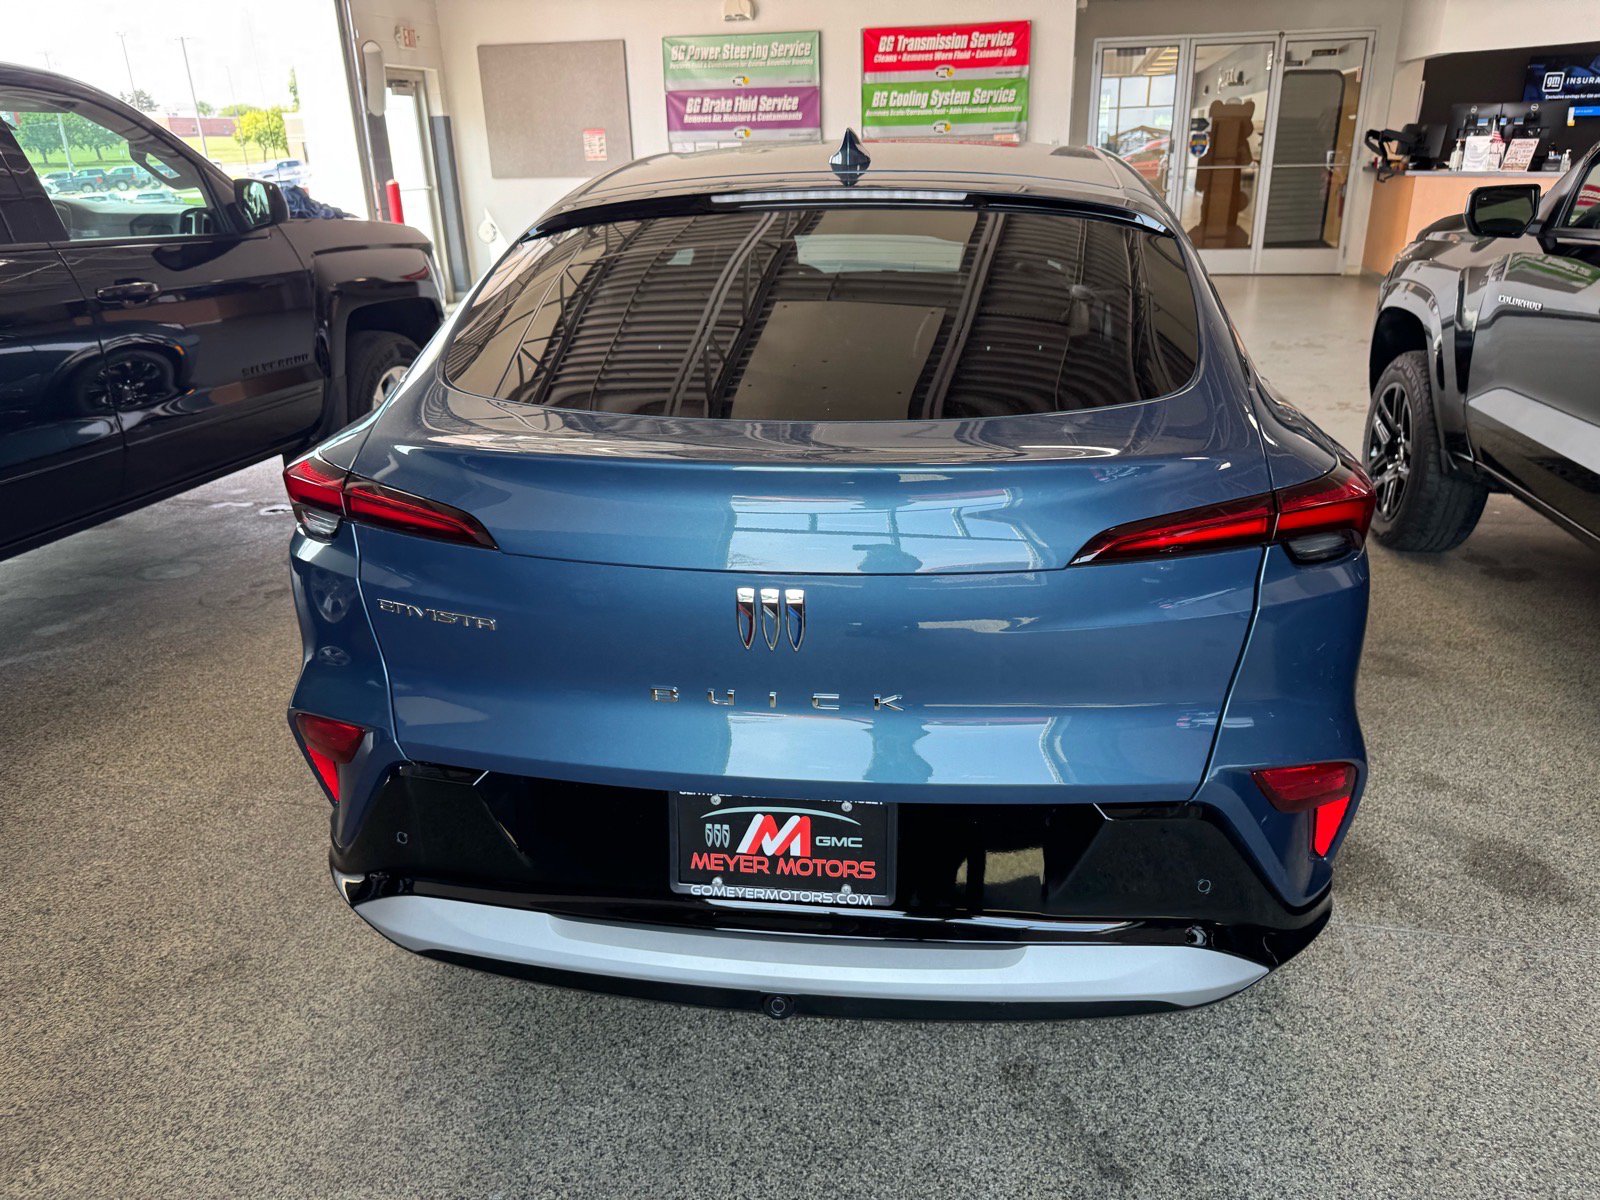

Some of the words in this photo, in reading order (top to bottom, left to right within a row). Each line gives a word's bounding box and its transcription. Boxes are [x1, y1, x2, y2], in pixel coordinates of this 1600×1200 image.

[671, 45, 686, 61] BG
[687, 46, 721, 60] Power
[722, 42, 769, 60] Steering
[771, 40, 812, 58] Service
[878, 35, 895, 52] BG
[896, 32, 969, 51] Transmission
[970, 30, 1015, 48] Service
[901, 52, 933, 62] Removes
[1003, 48, 1017, 57] Life
[686, 97, 702, 114] BG
[702, 96, 733, 113] Brake
[734, 95, 757, 112] Fluid
[759, 94, 800, 111] Service
[872, 91, 888, 107] BG
[889, 91, 929, 108] Cooling
[930, 89, 970, 107] System
[972, 87, 1017, 104] Service
[1498, 294, 1543, 311] COLORADO
[376, 598, 496, 631] ENVISTA
[650, 686, 904, 711] BUICK
[815, 836, 863, 848] GMC
[690, 852, 770, 875] MEYER
[776, 858, 876, 880] MOTORS
[690, 884, 873, 906] GOMEYERMOTORS.COM
